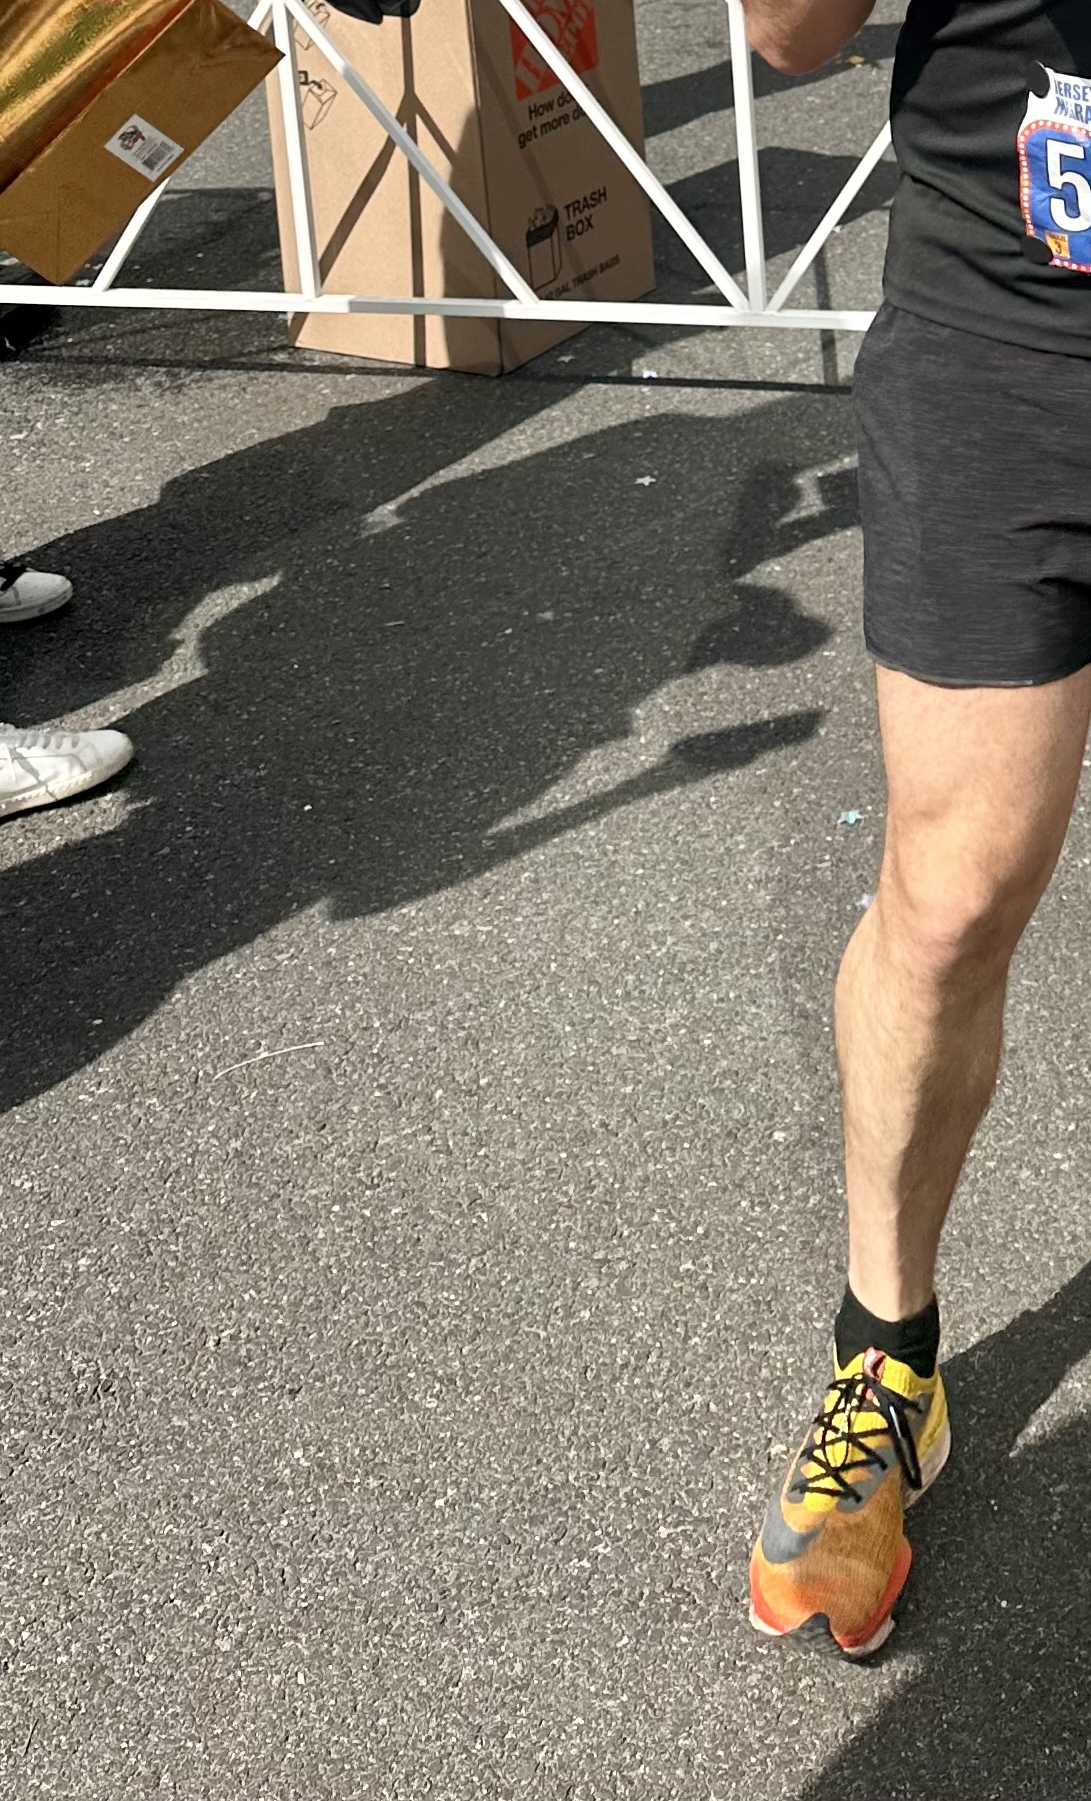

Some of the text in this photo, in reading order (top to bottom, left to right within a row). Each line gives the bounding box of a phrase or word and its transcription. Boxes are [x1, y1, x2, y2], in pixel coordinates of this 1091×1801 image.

[528, 100, 554, 121] How
[518, 125, 538, 150] get
[540, 112, 570, 135] more
[563, 185, 607, 220] TRASH
[566, 213, 594, 241] BOX
[572, 268, 598, 288] TRASH
[599, 254, 620, 274] BAGS
